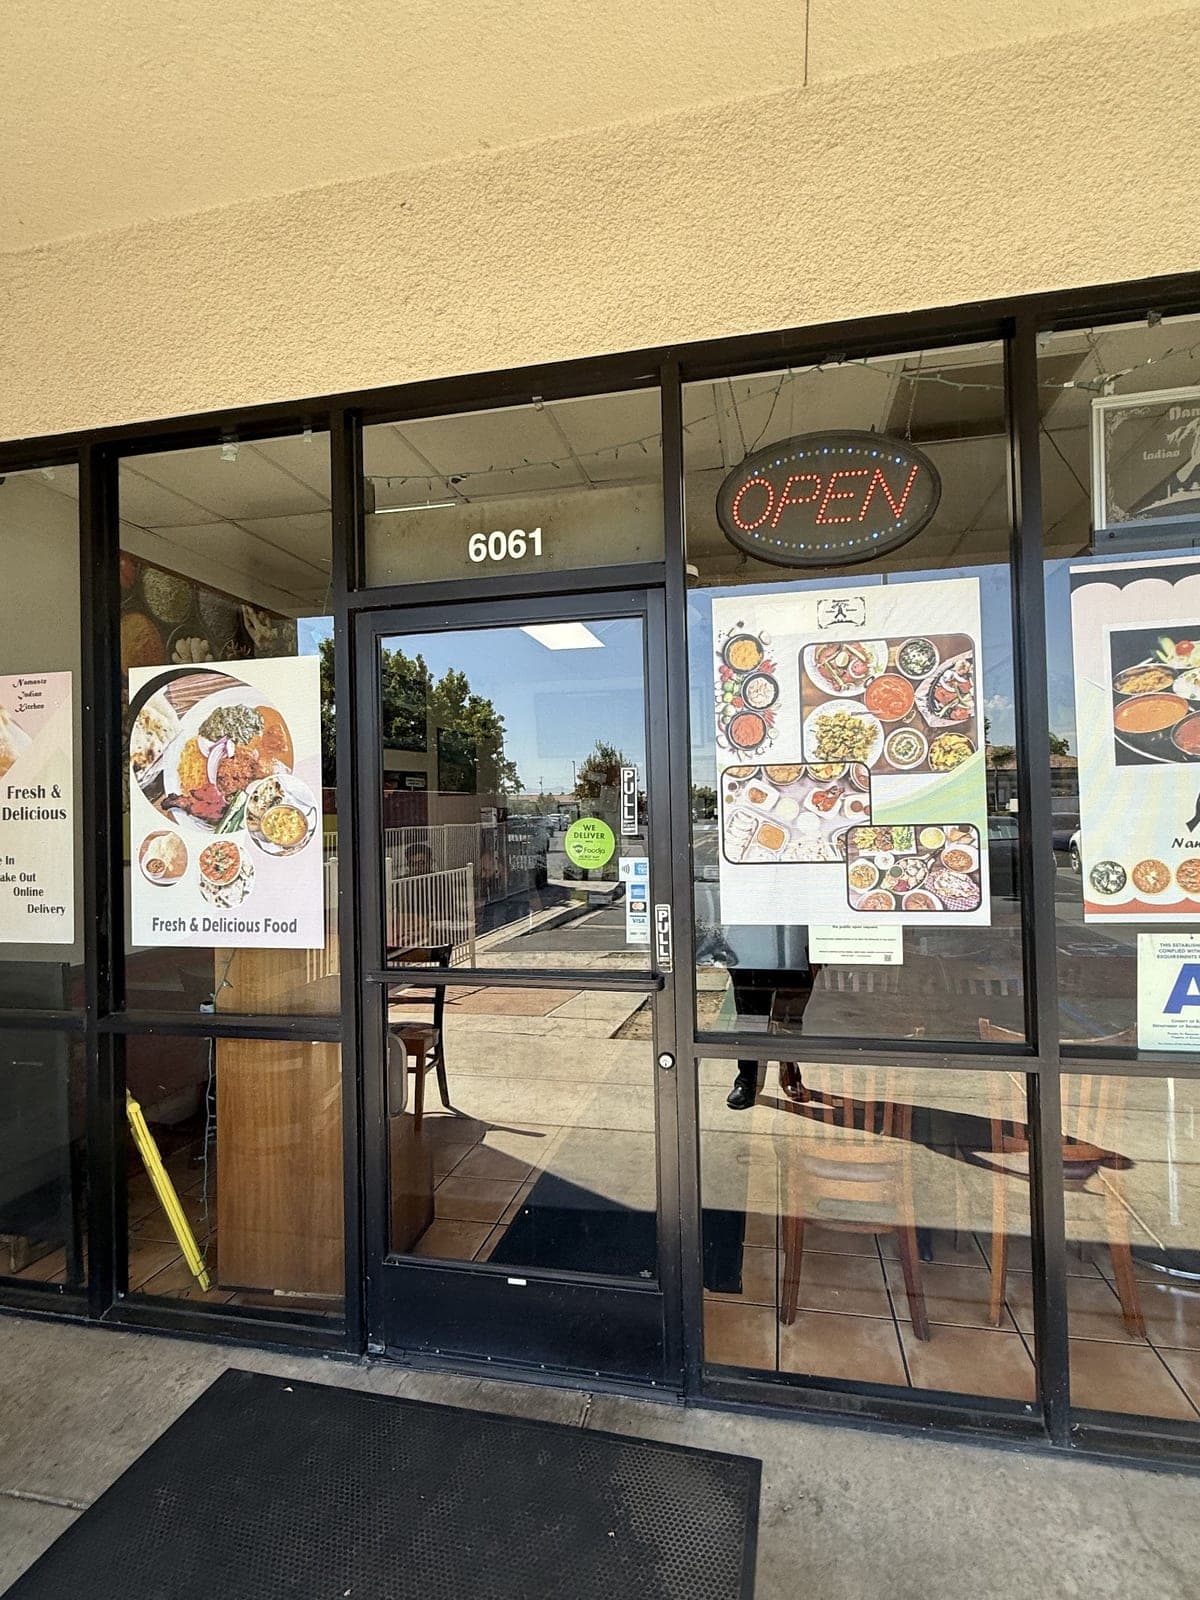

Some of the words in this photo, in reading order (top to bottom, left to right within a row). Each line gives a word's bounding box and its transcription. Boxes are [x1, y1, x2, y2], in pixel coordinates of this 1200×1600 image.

[732, 464, 919, 531] OPEN
[468, 527, 543, 562] 6061
[7, 784, 46, 800] Fresh
[51, 784, 62, 799] &
[623, 770, 635, 819] PULL
[2, 806, 67, 821] Delicious
[573, 831, 606, 839] DELIVER
[5, 855, 15, 865] In
[0, 872, 17, 882] ake
[19, 872, 37, 882] Out
[13, 886, 44, 897] Online
[27, 903, 66, 916] Delivery
[152, 917, 186, 932] Fresh
[189, 917, 199, 932] &
[202, 917, 260, 933] Delicious
[264, 918, 297, 933] Food
[657, 910, 669, 956] PULL
[1162, 963, 1200, 1014] A
